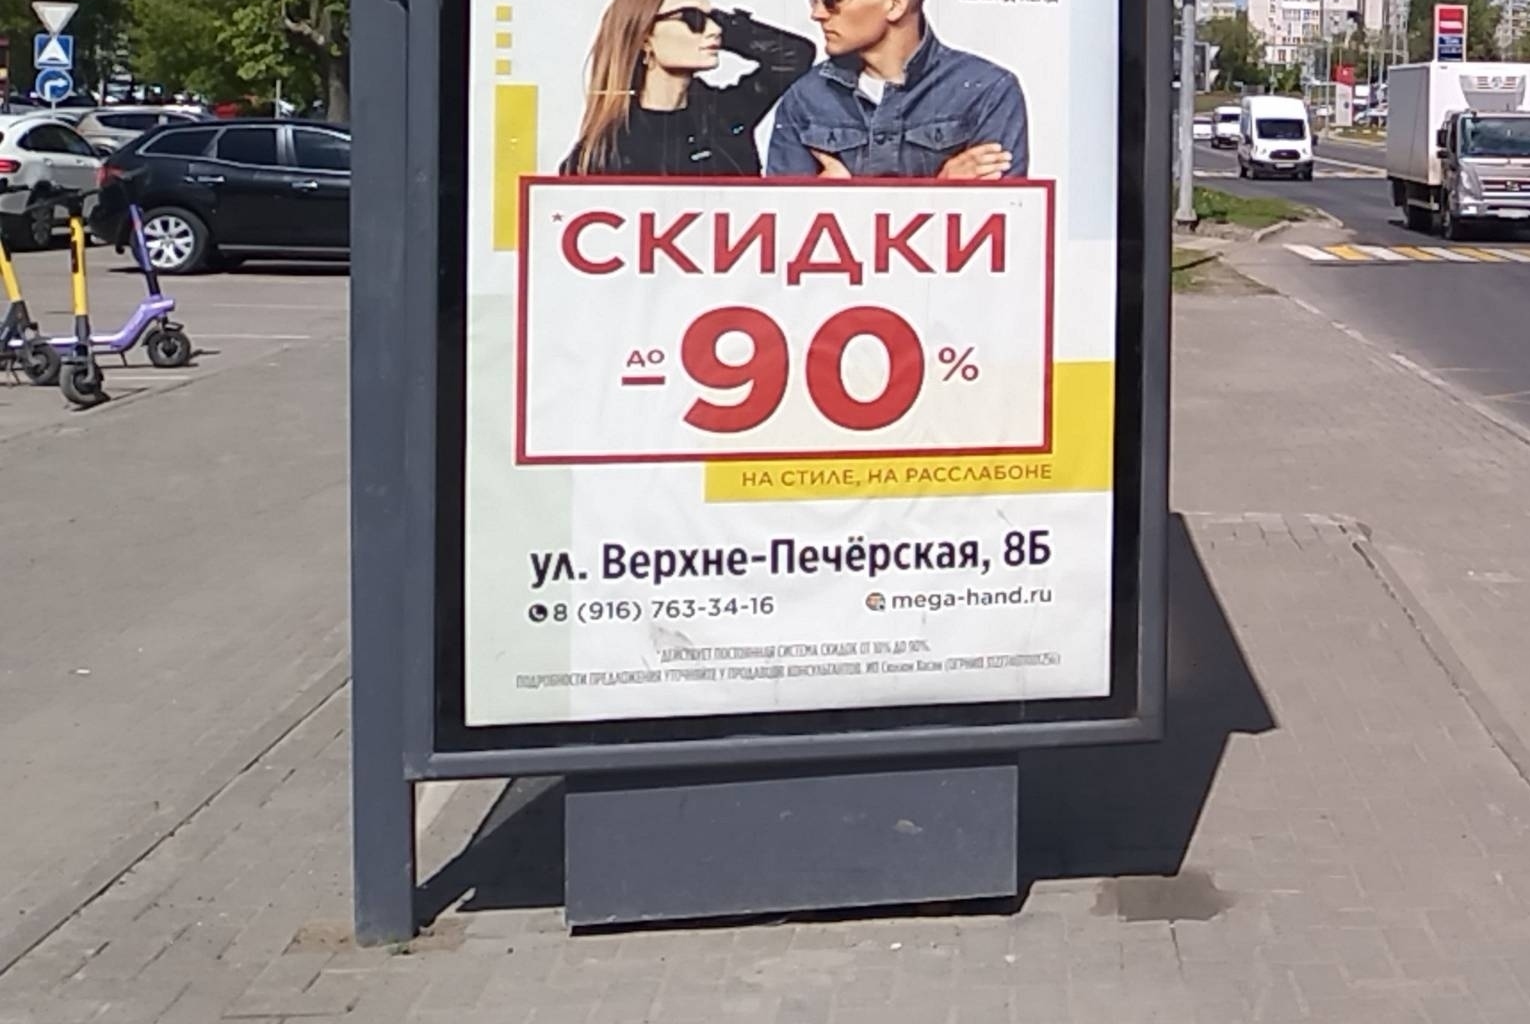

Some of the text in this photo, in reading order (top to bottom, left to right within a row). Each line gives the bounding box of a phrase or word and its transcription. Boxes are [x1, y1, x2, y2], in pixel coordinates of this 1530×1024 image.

[741, 463, 1053, 487] НА СТИЛЕ, НА РАССЛАБОНЕ
[530, 530, 1051, 589] ул. Верхне-Печёрская, 8Б
[553, 595, 775, 623] 8 (916) 763-34-16
[892, 586, 1051, 611] mega-hand.ru
